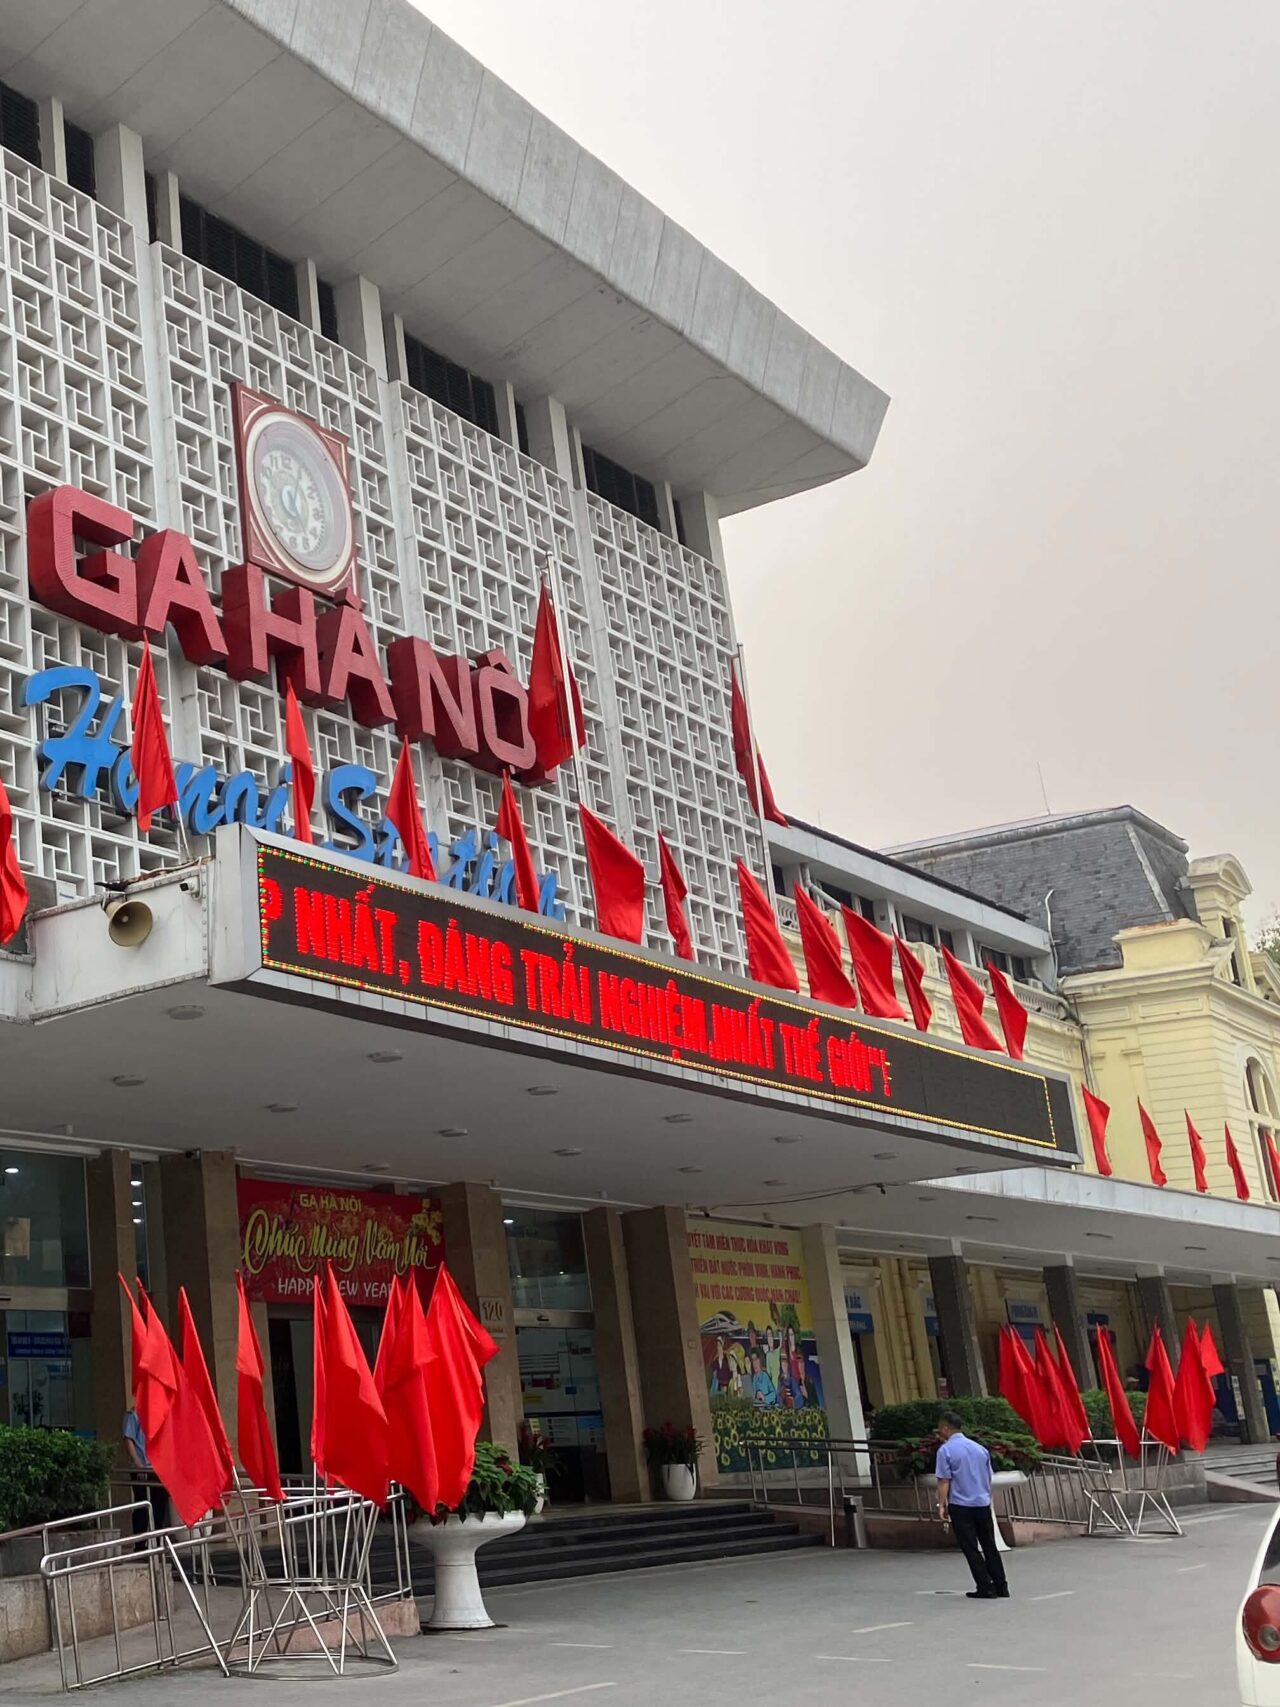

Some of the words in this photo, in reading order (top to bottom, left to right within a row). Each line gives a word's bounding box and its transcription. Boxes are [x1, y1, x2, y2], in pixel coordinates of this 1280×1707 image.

[27, 484, 228, 667] GA
[222, 562, 397, 729] HÀ
[387, 635, 557, 788] NỘ
[520, 942, 593, 1025] TRẢI
[299, 1193, 318, 1209] GA
[320, 1191, 338, 1210] HÀ
[338, 1195, 362, 1215] NỘI
[241, 1209, 315, 1275] Chúc
[309, 1221, 359, 1273] Mừng
[278, 1278, 323, 1295] HAPP
[338, 1280, 358, 1296] EW
[482, 1301, 503, 1321] 120
